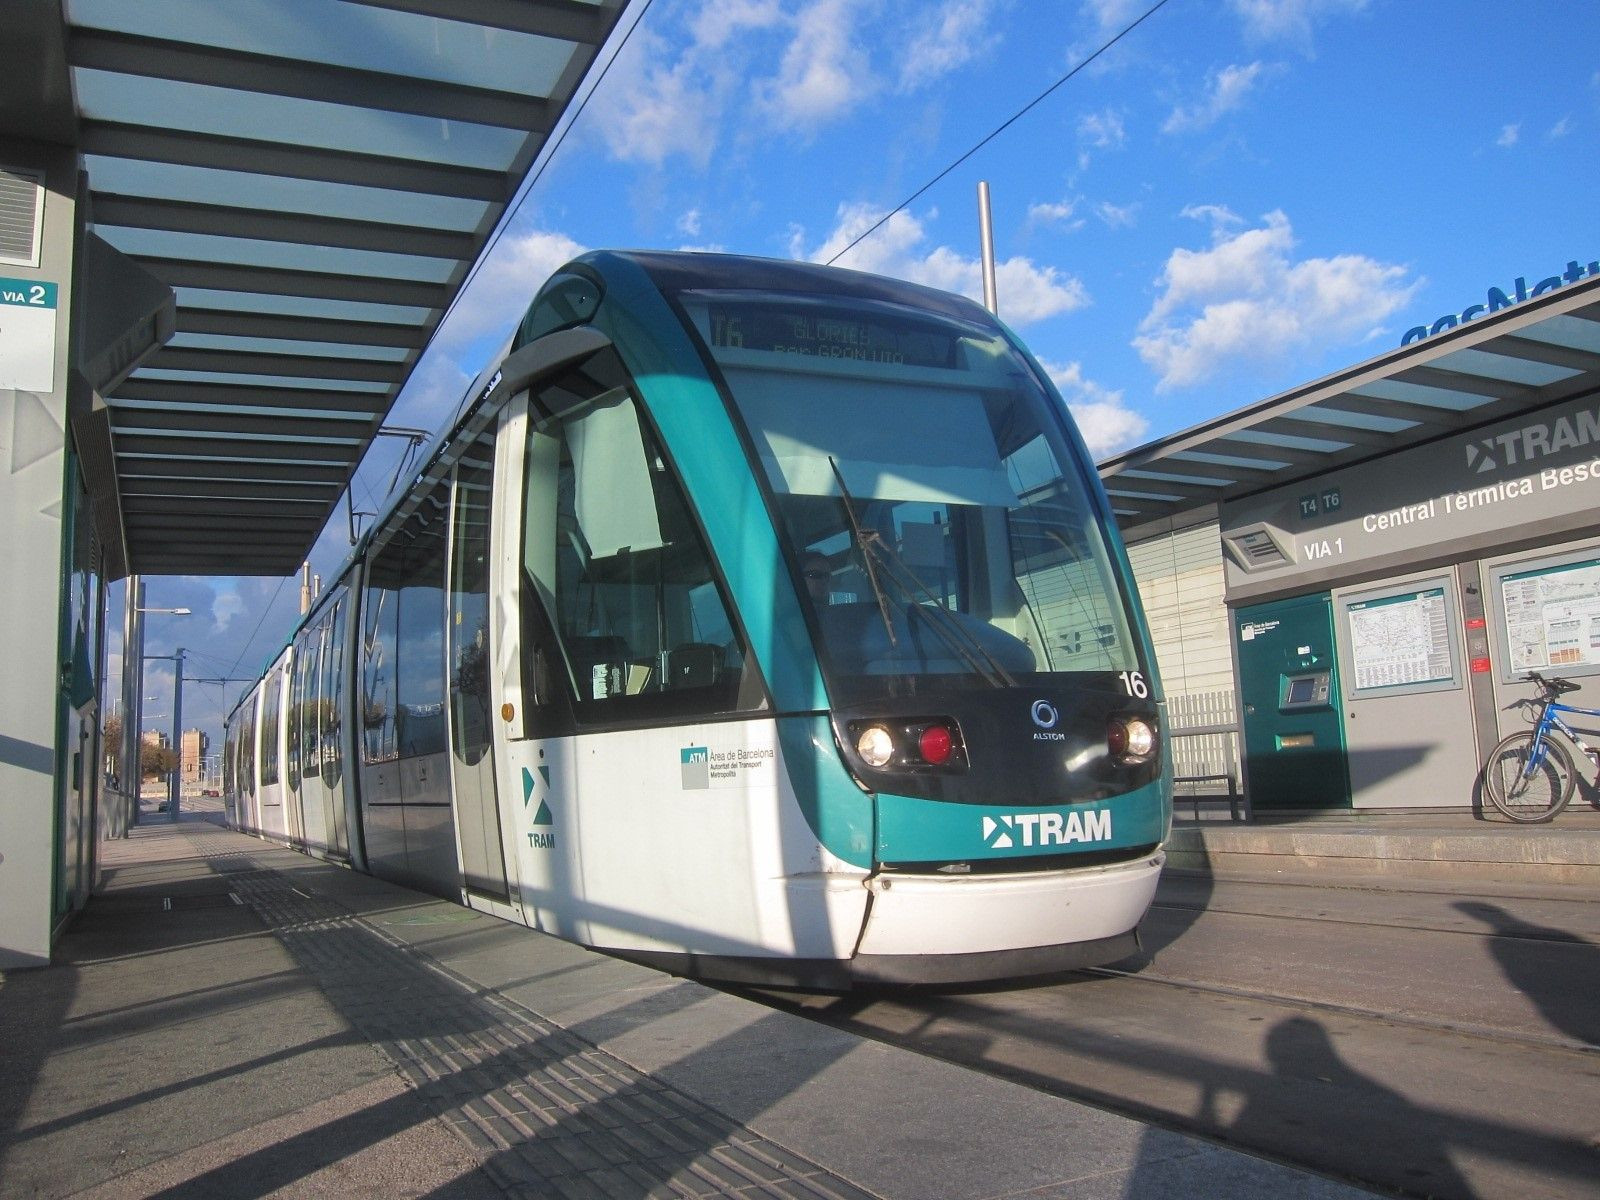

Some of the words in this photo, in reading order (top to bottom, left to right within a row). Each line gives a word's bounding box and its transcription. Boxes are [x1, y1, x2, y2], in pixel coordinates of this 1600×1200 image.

[3, 291, 25, 302] VIA
[29, 285, 45, 304] 2
[1301, 499, 1317, 513] T4
[1323, 493, 1339, 508] T6
[1363, 497, 1435, 533] Central
[1441, 477, 1533, 515] Tèrmica
[1304, 540, 1331, 560] VIA
[1335, 537, 1343, 554] 1
[1119, 671, 1148, 698] 16
[1033, 732, 1066, 741] ALSTOM
[690, 752, 706, 764] ATM
[727, 750, 735, 760] de
[738, 748, 774, 760] Barcelona
[739, 761, 761, 770] Transport
[1014, 809, 1112, 847] TRAM
[528, 833, 555, 849] TRAM
